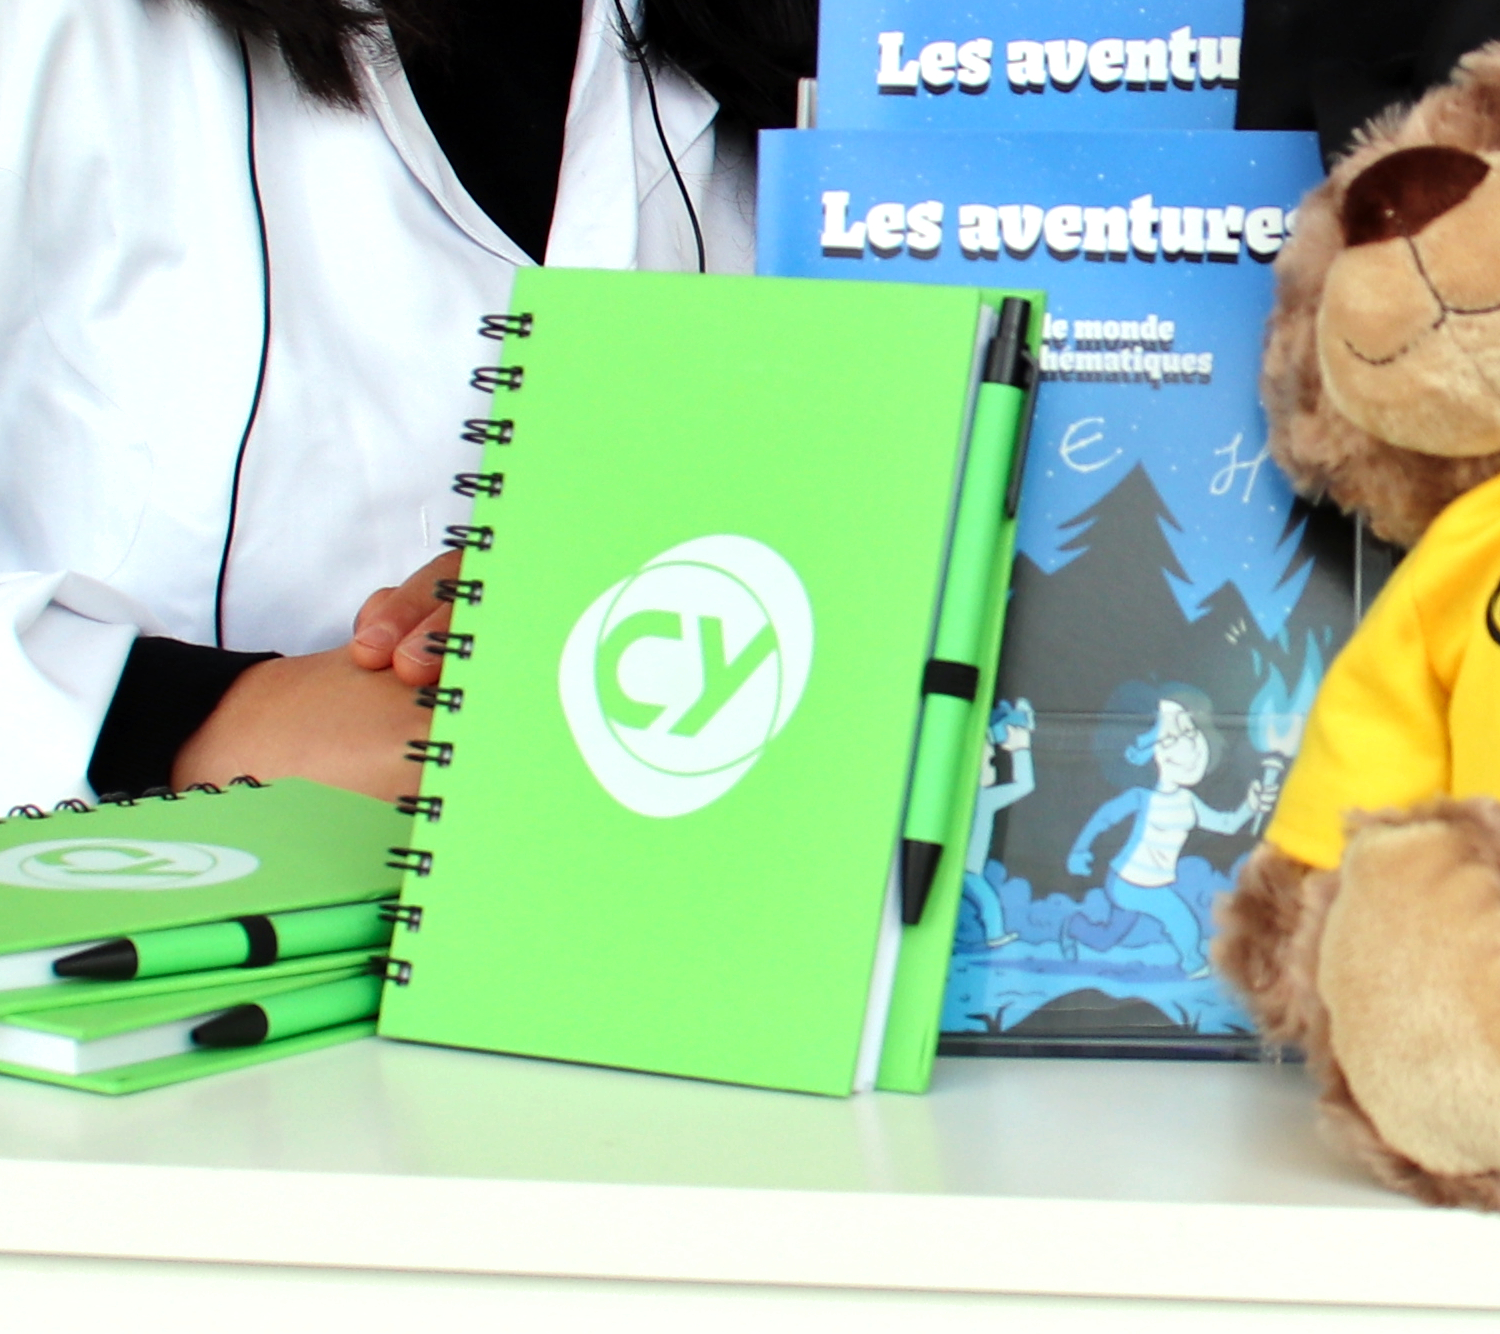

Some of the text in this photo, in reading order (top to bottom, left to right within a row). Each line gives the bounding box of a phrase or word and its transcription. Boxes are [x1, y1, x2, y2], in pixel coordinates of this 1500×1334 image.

[877, 27, 1241, 94] Les aventu
[821, 191, 943, 258] Les
[1074, 314, 1175, 352] monde
[1039, 344, 1213, 389] hématiques
